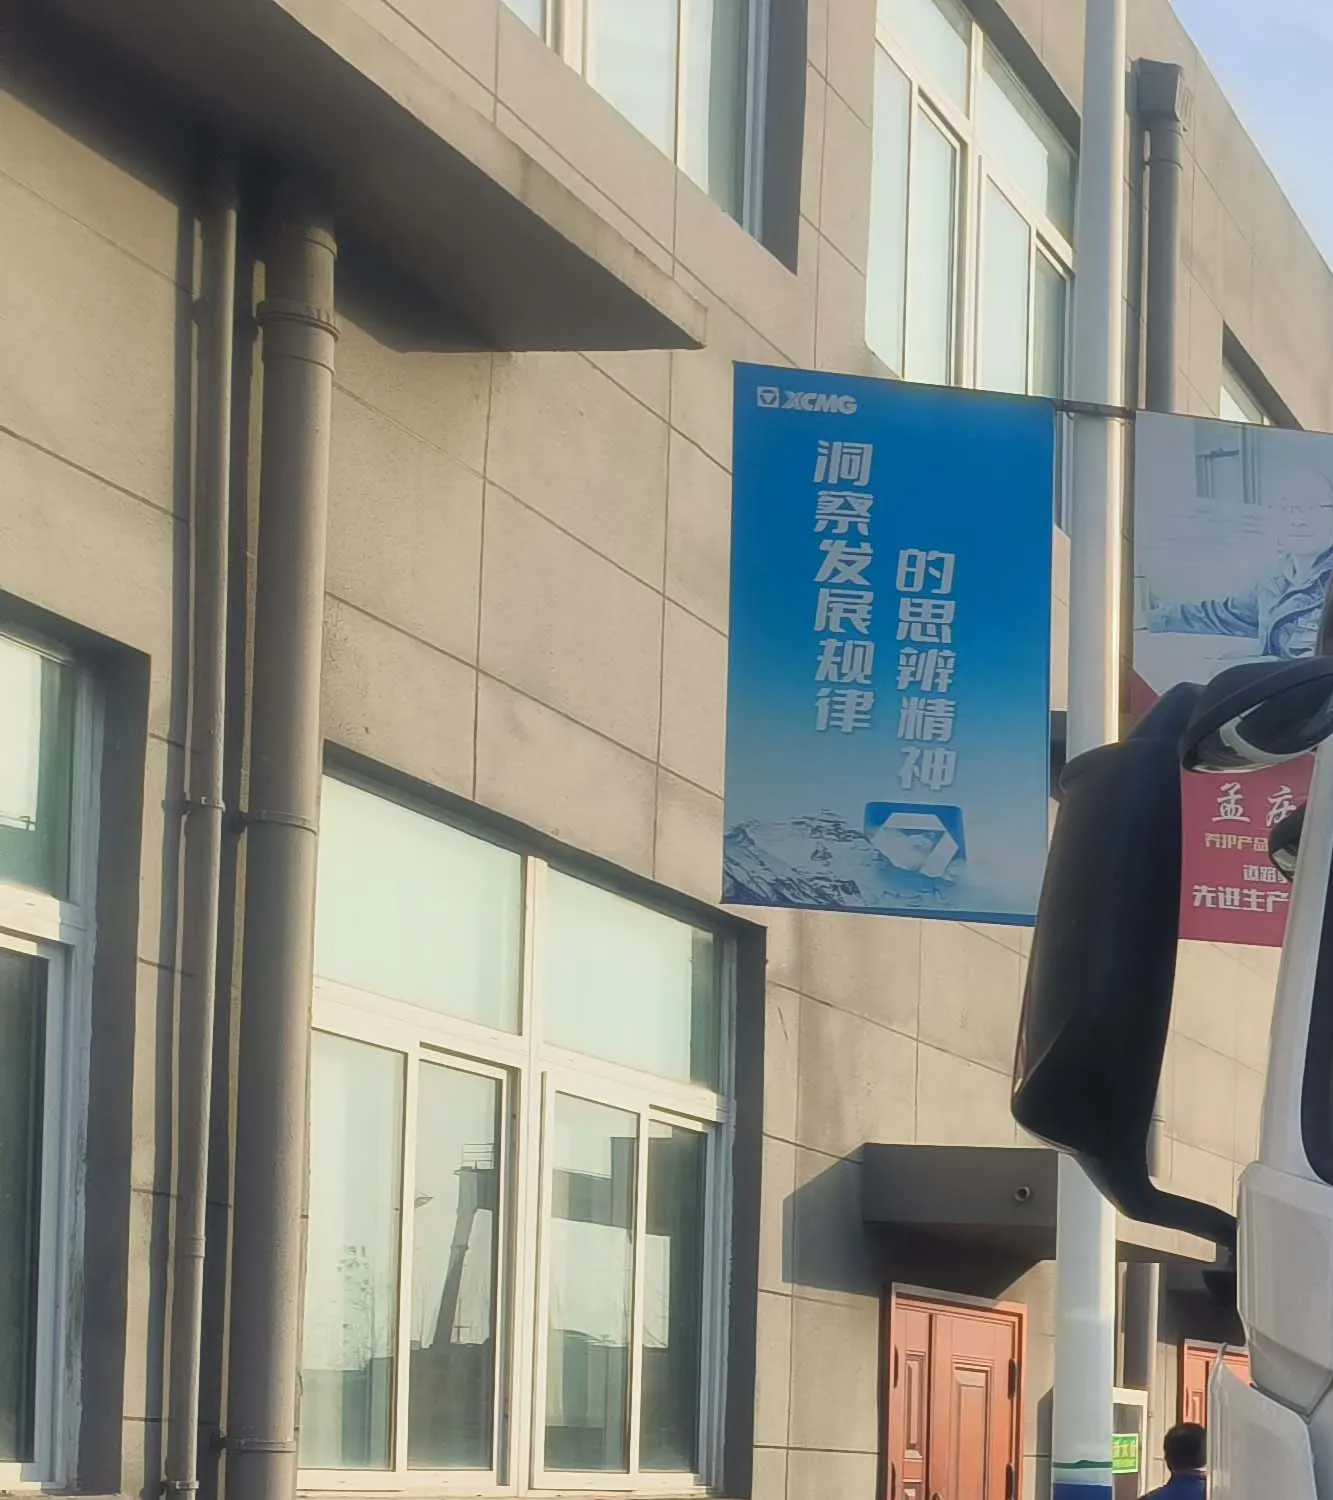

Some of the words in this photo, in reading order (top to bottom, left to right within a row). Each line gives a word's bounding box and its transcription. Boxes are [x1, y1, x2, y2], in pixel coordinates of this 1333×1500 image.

[781, 390, 858, 415] XCMG
[813, 439, 875, 734] 洞察发展规律
[896, 548, 958, 792] 的思辨精神
